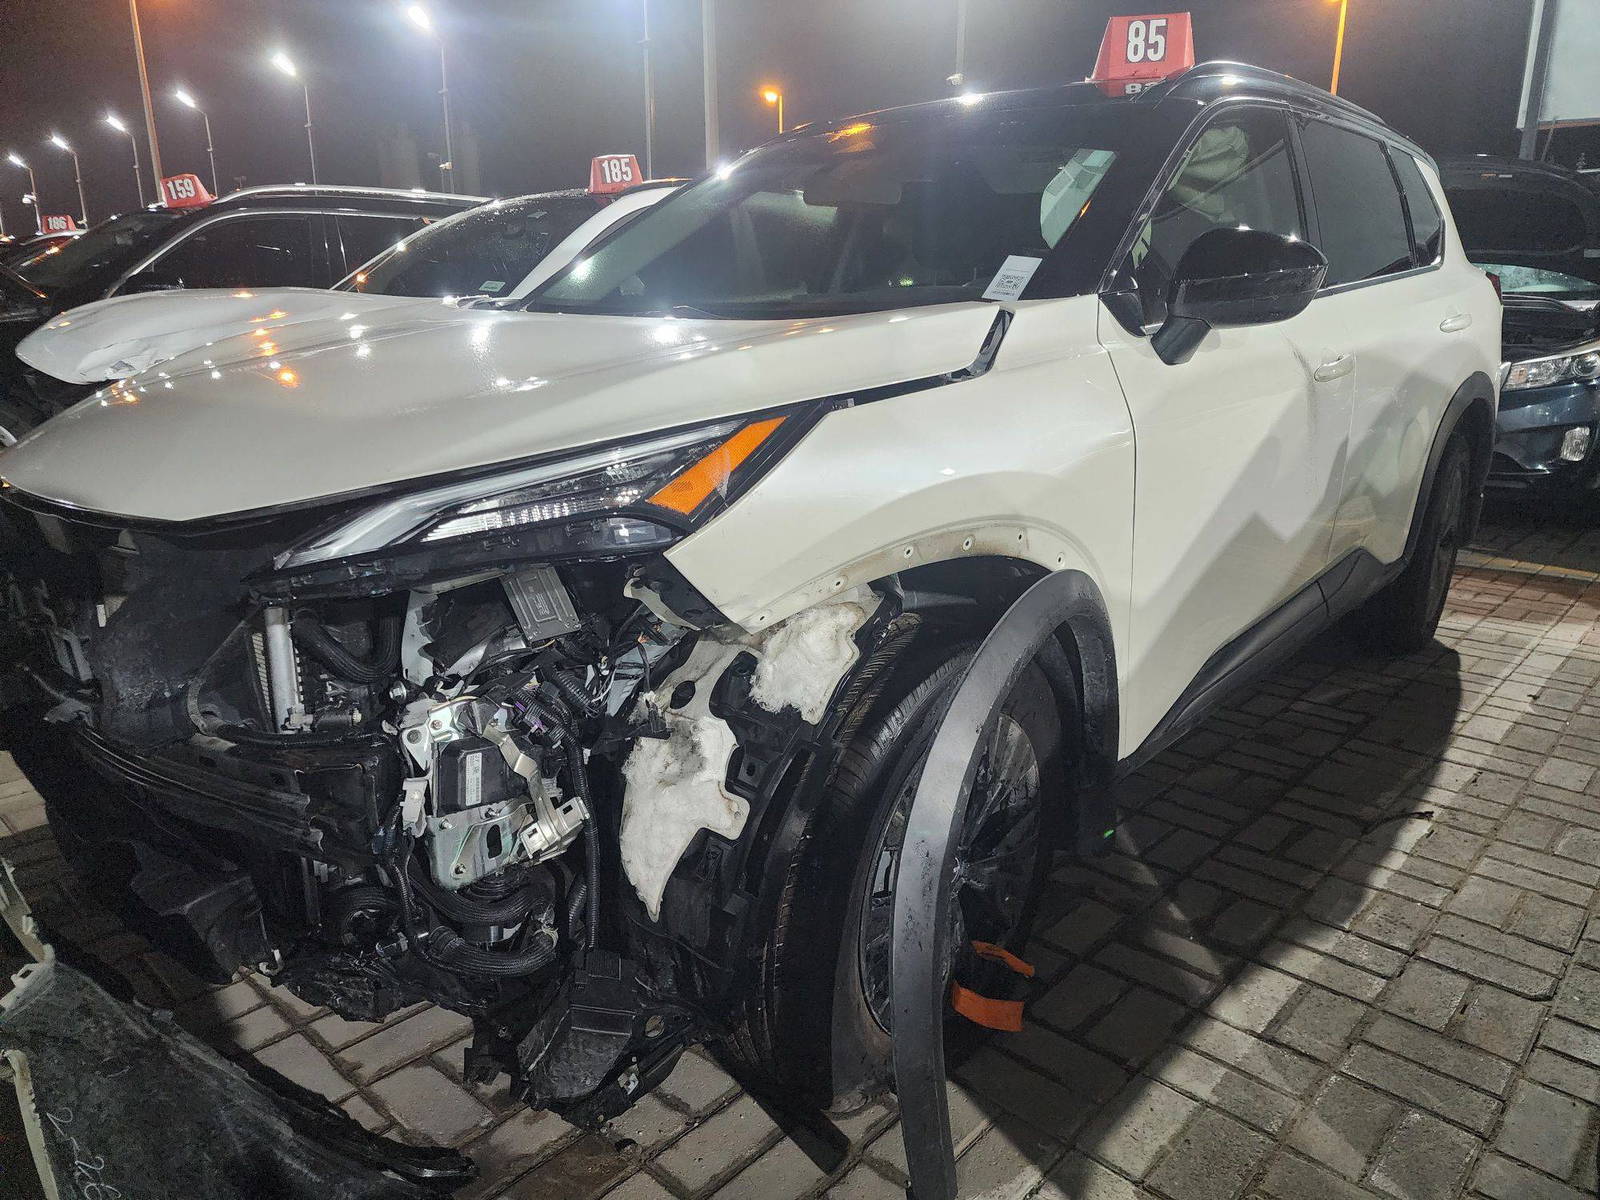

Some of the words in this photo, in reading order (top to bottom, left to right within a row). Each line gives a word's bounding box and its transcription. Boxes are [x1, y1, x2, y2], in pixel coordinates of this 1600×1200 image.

[1127, 19, 1167, 62] 85
[602, 158, 632, 183] 185
[167, 178, 196, 200] 159
